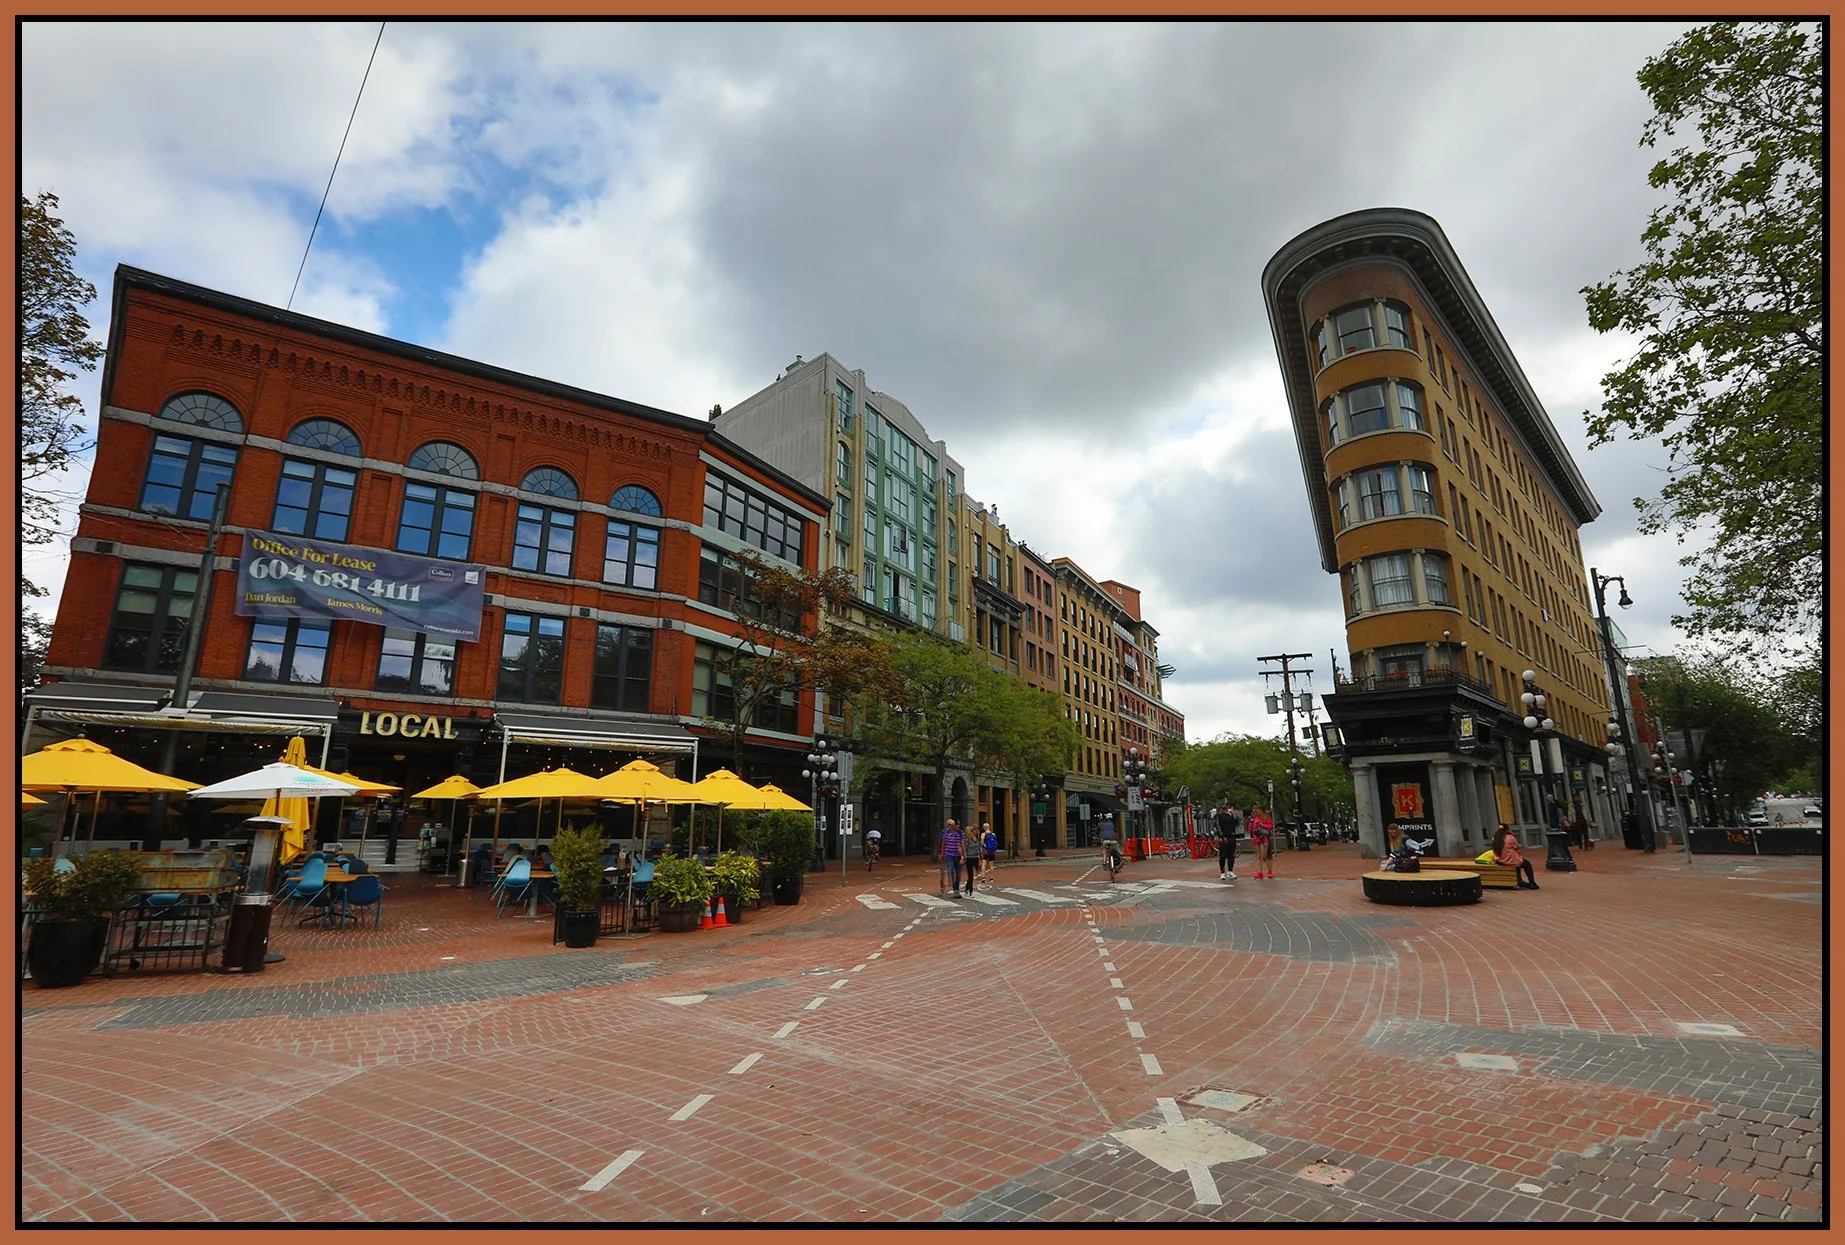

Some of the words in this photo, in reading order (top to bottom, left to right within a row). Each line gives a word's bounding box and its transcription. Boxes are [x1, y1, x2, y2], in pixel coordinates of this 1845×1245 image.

[252, 537, 299, 557] Office
[302, 547, 330, 564] For
[332, 552, 377, 572] Lease
[250, 556, 307, 583] 604
[312, 569, 361, 593] 681
[367, 579, 421, 602] 4111
[431, 569, 452, 577] Colliers
[245, 592, 264, 601] Dan
[265, 594, 297, 604] Jordan
[328, 598, 355, 608] James
[355, 602, 383, 616] Morris
[360, 711, 460, 740] LOCAL
[1397, 823, 1433, 831] MPRINTS
